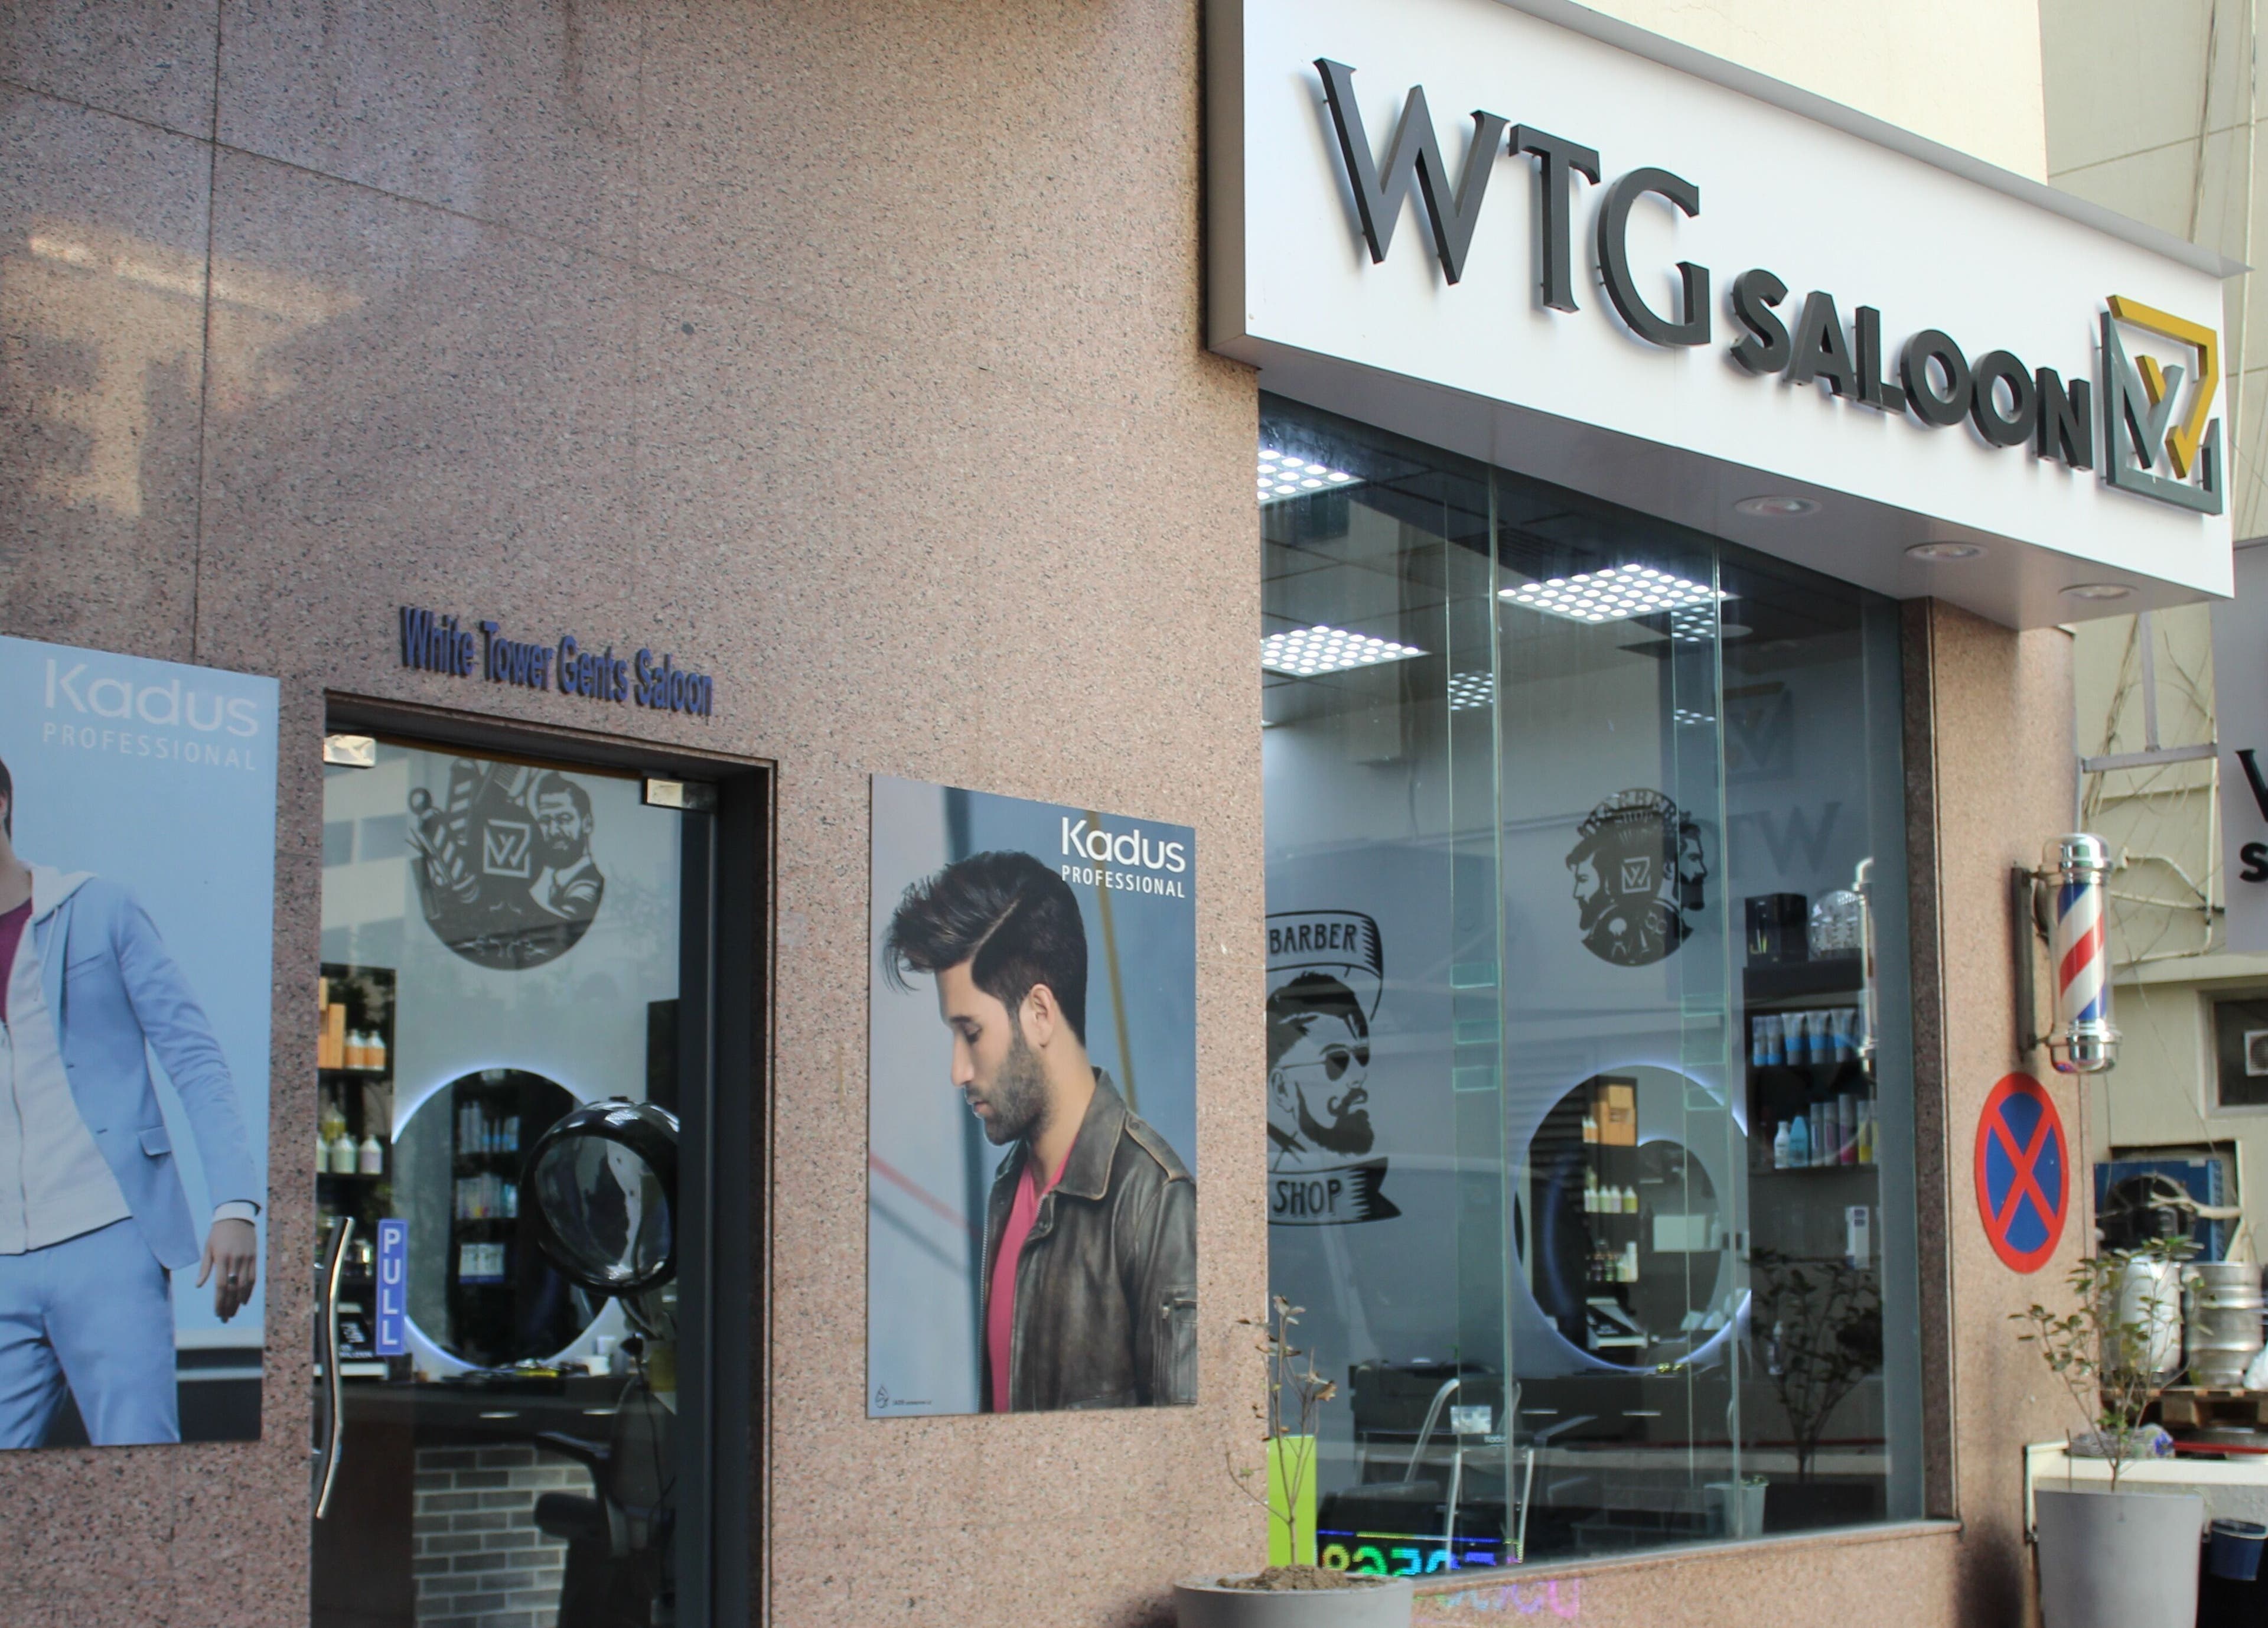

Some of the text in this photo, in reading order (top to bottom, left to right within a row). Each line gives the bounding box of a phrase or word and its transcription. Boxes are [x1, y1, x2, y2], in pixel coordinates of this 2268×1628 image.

[1312, 57, 2093, 472] WTG SALOON
[400, 606, 713, 716] White Tower Gents Saloon
[45, 659, 259, 737] Kadus
[43, 723, 256, 771] PROFESSIONAL
[1062, 817, 1186, 873] Kadus
[1062, 864, 1185, 898] PROFESSIONAL
[1268, 923, 1358, 955] BARBER
[1273, 1179, 1343, 1216] SHOP
[382, 1228, 401, 1345] PULL
